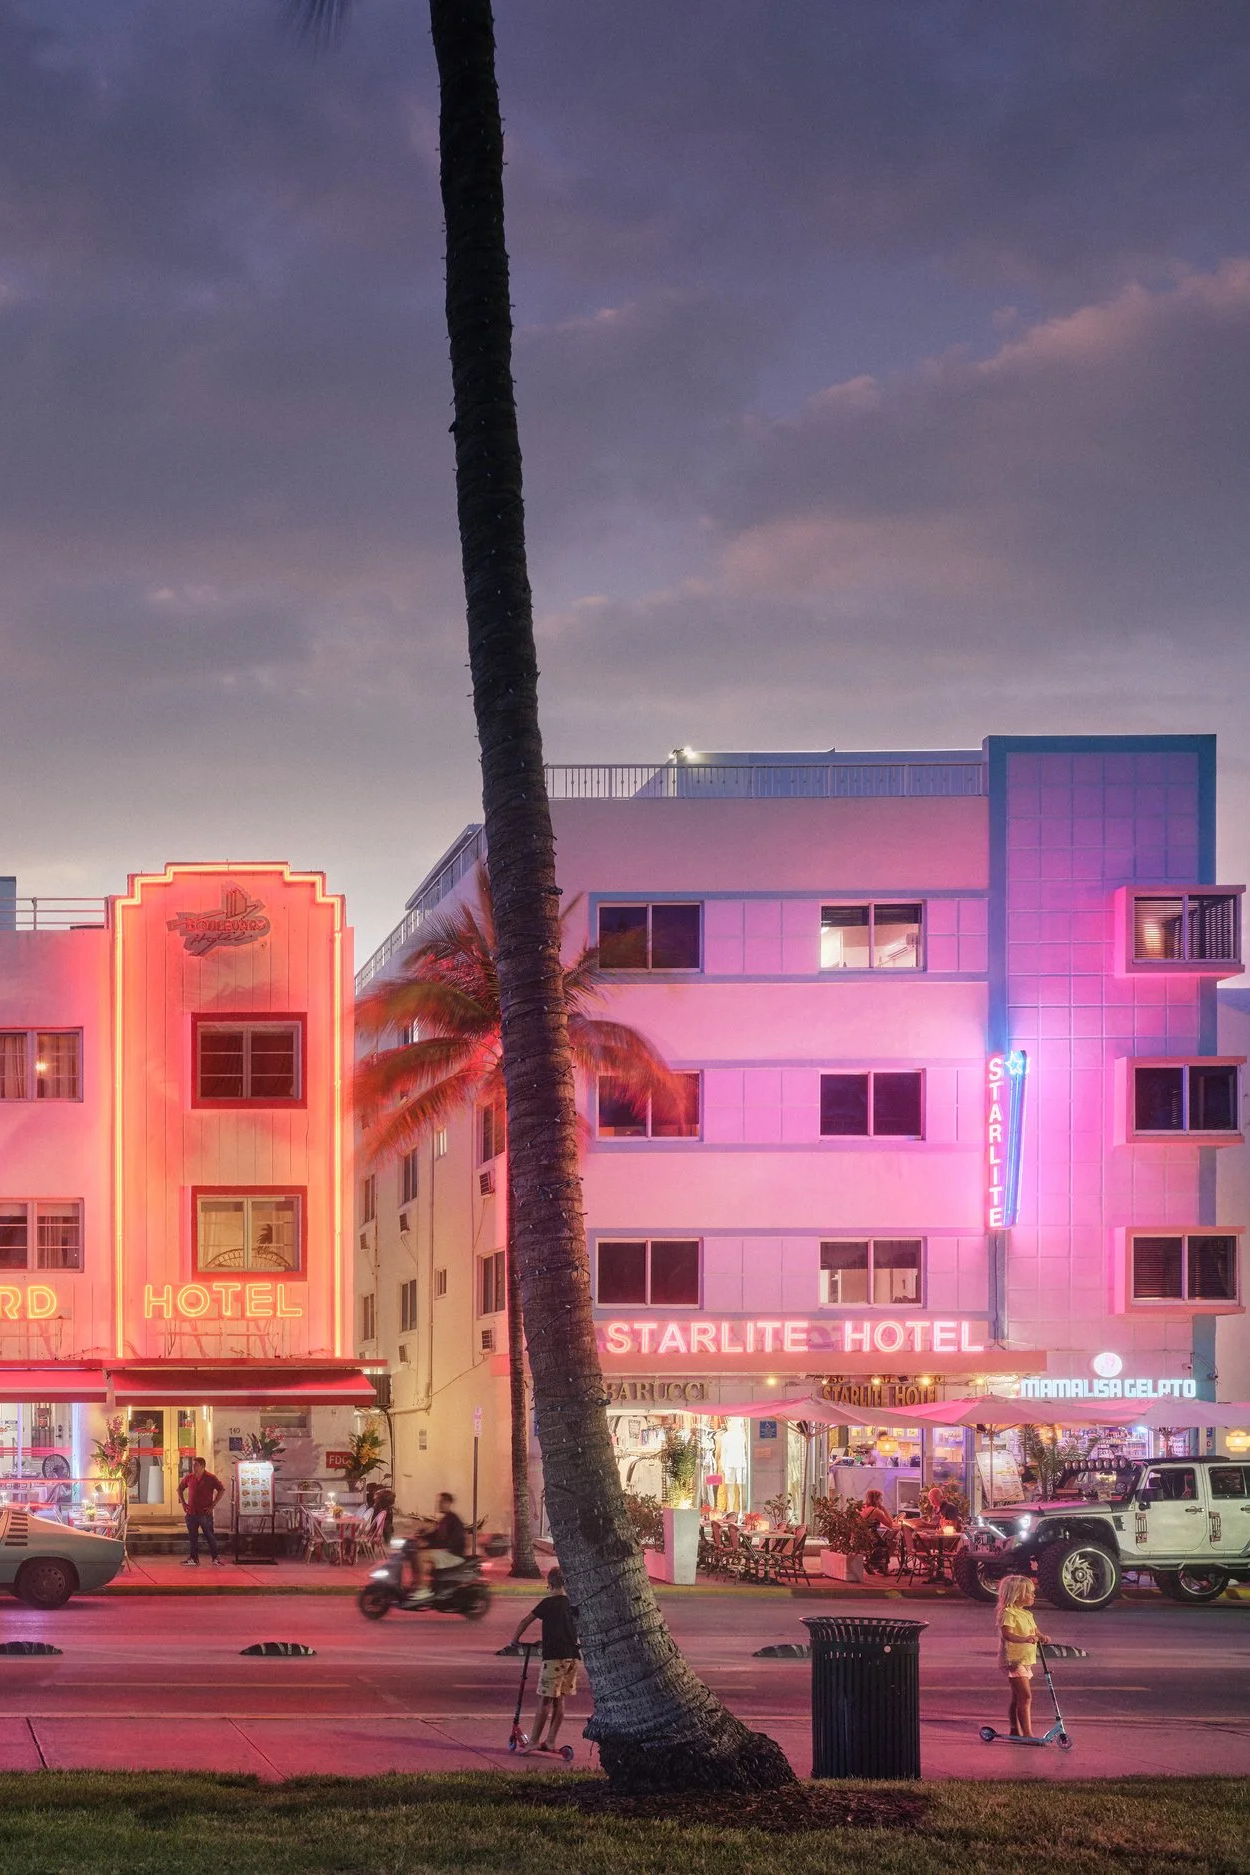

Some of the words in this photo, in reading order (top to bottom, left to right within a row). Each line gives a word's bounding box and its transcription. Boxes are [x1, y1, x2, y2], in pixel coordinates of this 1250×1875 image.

[988, 1057, 1005, 1227] STARLITE
[144, 1282, 303, 1319] HOTEL
[605, 1321, 809, 1354] STARLITE
[843, 1321, 985, 1353] HOTEL
[602, 1382, 709, 1401] BARUCCI
[822, 1384, 891, 1407] STARLITE
[894, 1384, 940, 1407] HOTEL
[1021, 1379, 1122, 1398] MAMALISA
[1124, 1379, 1197, 1397] GELATO
[329, 1455, 349, 1465] FDC
